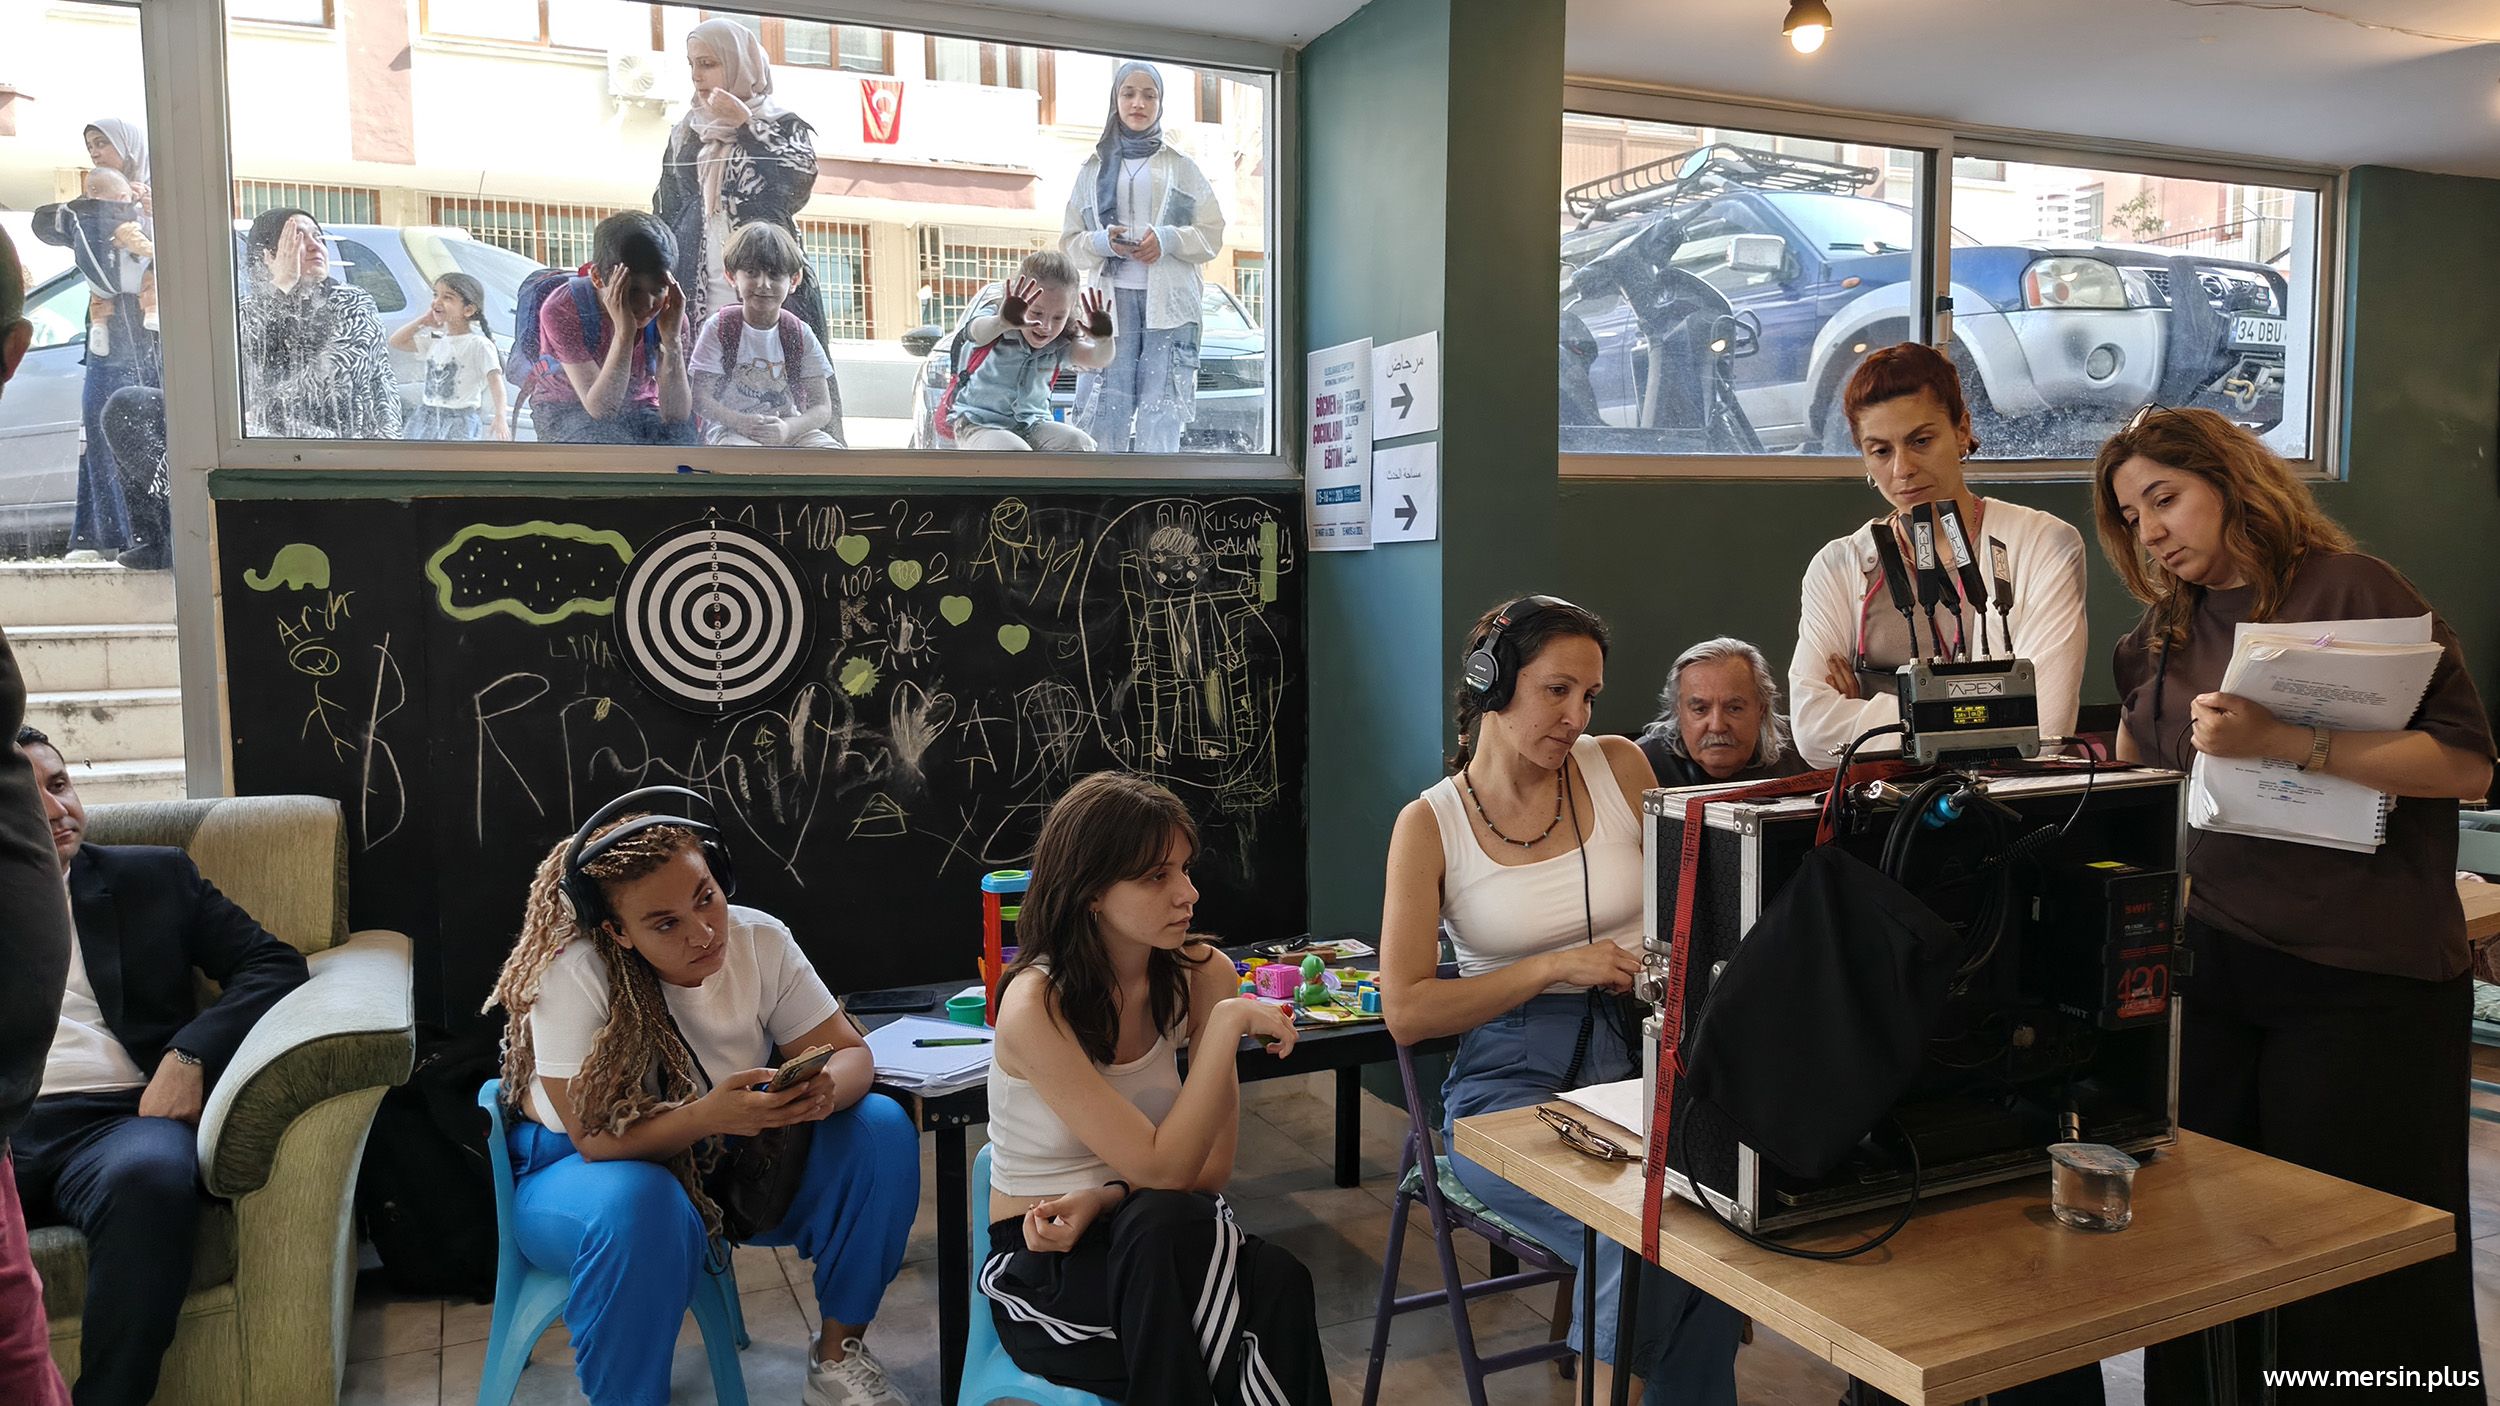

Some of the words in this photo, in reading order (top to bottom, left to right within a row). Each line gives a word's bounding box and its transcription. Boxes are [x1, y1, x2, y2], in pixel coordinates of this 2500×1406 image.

[2238, 320, 2255, 341] 34
[2258, 322, 2282, 343] DBU
[710, 520, 716, 529] 1
[1202, 510, 1276, 533] KUSURA
[710, 532, 717, 540] 2
[710, 542, 717, 550] 3
[711, 563, 719, 571] 5
[712, 573, 719, 581] 6
[712, 583, 719, 591] 7
[713, 593, 720, 601] 8
[713, 604, 720, 612] 9
[714, 621, 721, 630] 9
[715, 631, 722, 639] 8
[715, 641, 722, 650] 7
[716, 662, 723, 670] 5
[716, 672, 722, 680] 4
[716, 682, 723, 690] 3
[1950, 682, 2002, 696] APEX
[717, 692, 724, 700] 2
[717, 702, 724, 711] 1
[2058, 1002, 2089, 1019] SWIT
